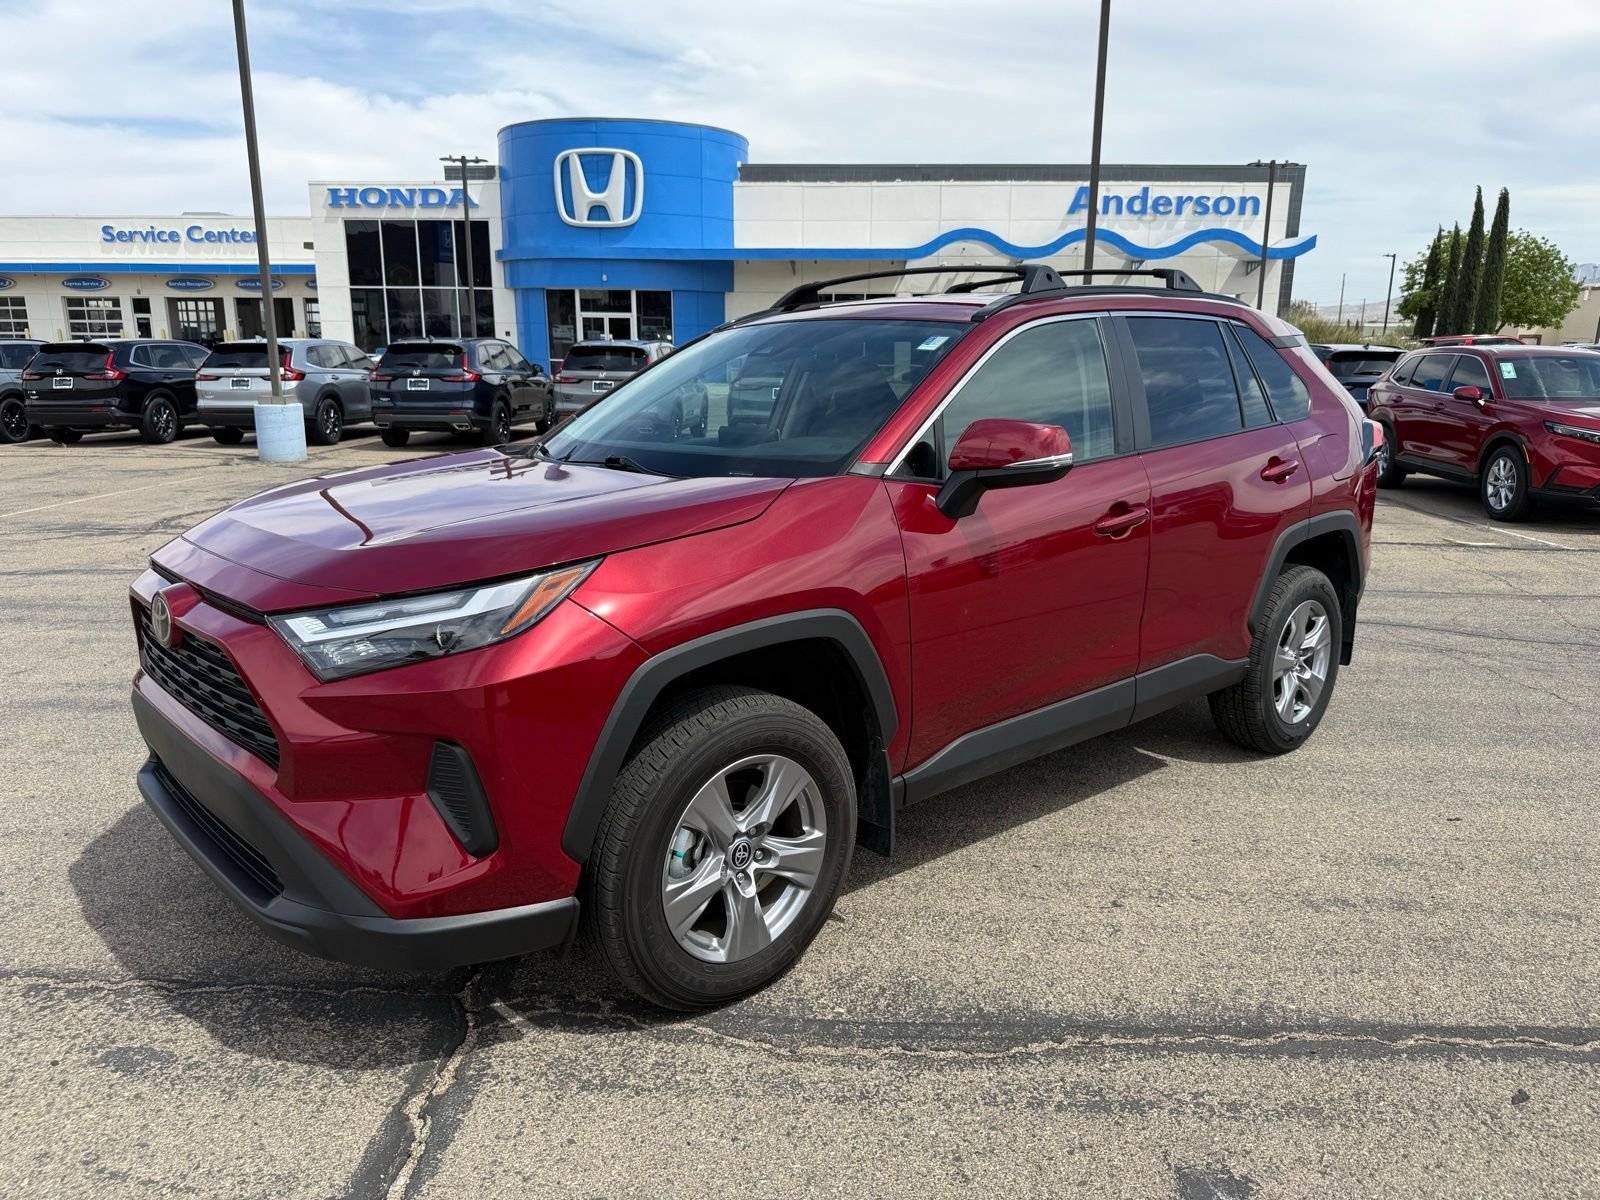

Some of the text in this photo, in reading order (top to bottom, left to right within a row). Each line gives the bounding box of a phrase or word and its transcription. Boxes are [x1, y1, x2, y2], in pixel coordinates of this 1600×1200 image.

[327, 187, 479, 209] HONDA
[1066, 186, 1261, 216] Anderson
[101, 225, 181, 243] Service
